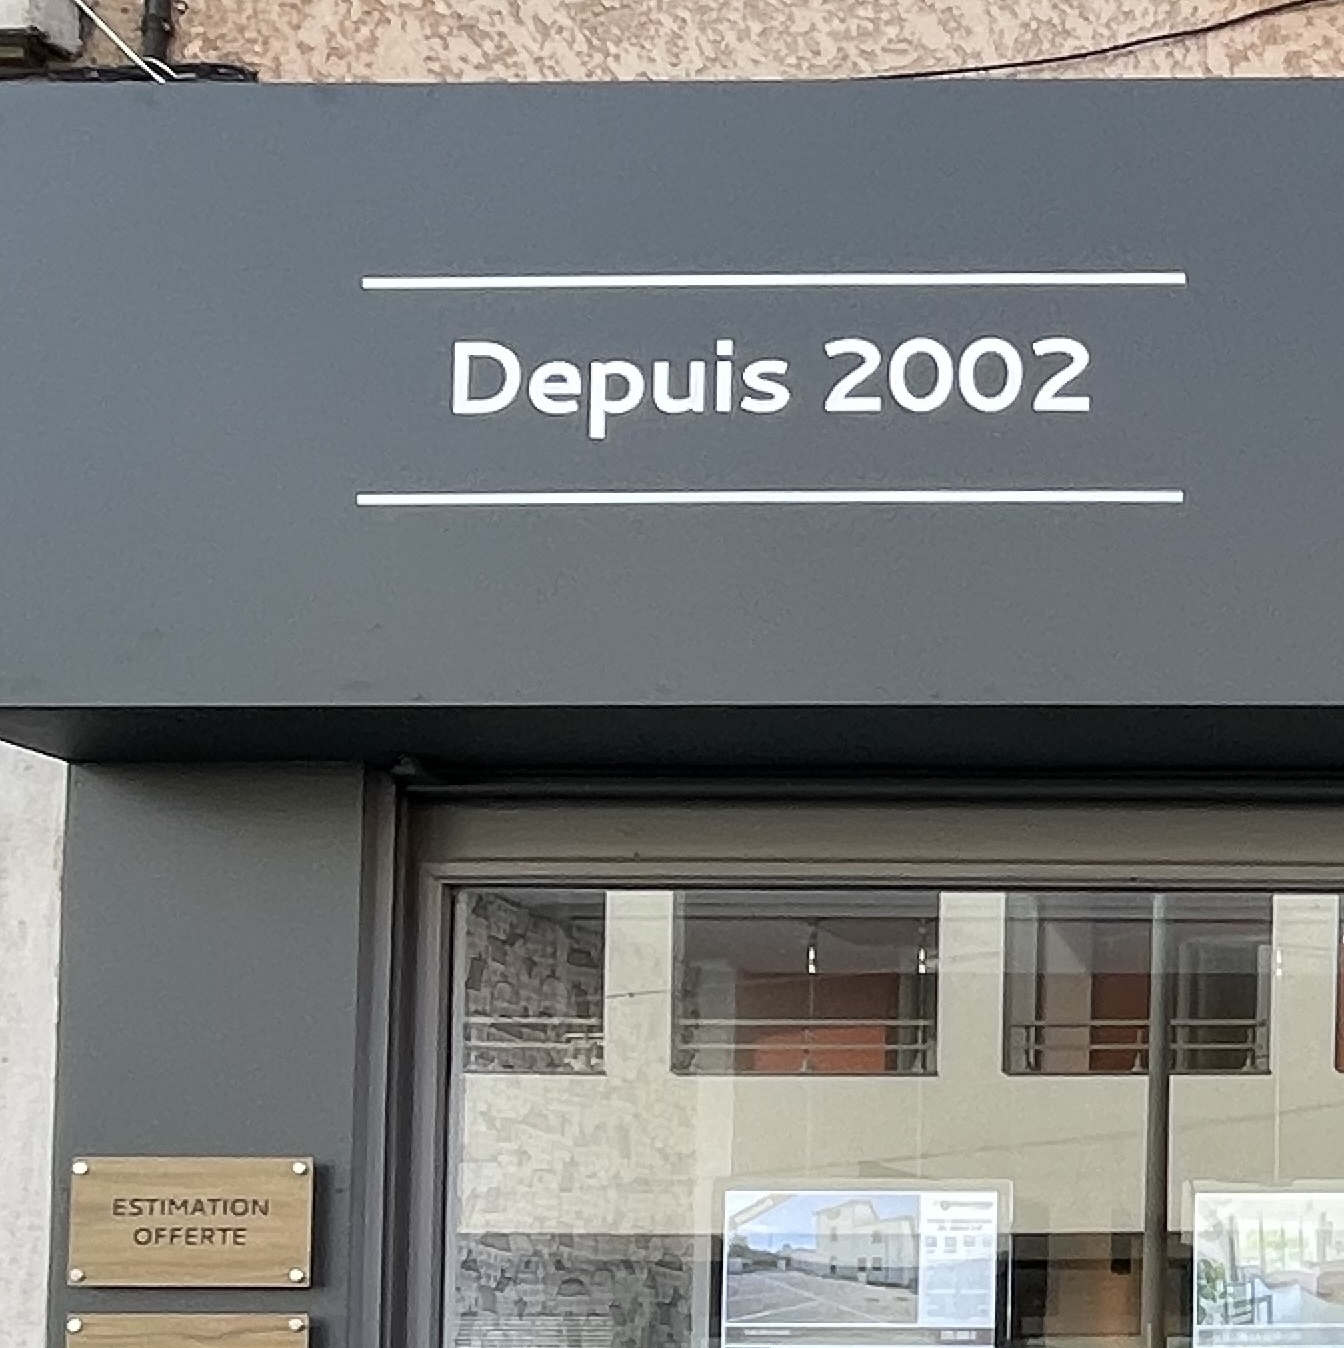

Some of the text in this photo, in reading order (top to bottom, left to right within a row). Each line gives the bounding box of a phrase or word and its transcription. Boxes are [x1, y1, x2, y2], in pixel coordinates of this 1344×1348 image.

[452, 339, 1092, 439] Depuis 2002
[112, 1198, 270, 1217] ESTIMATION
[133, 1227, 248, 1246] OFFERTE
